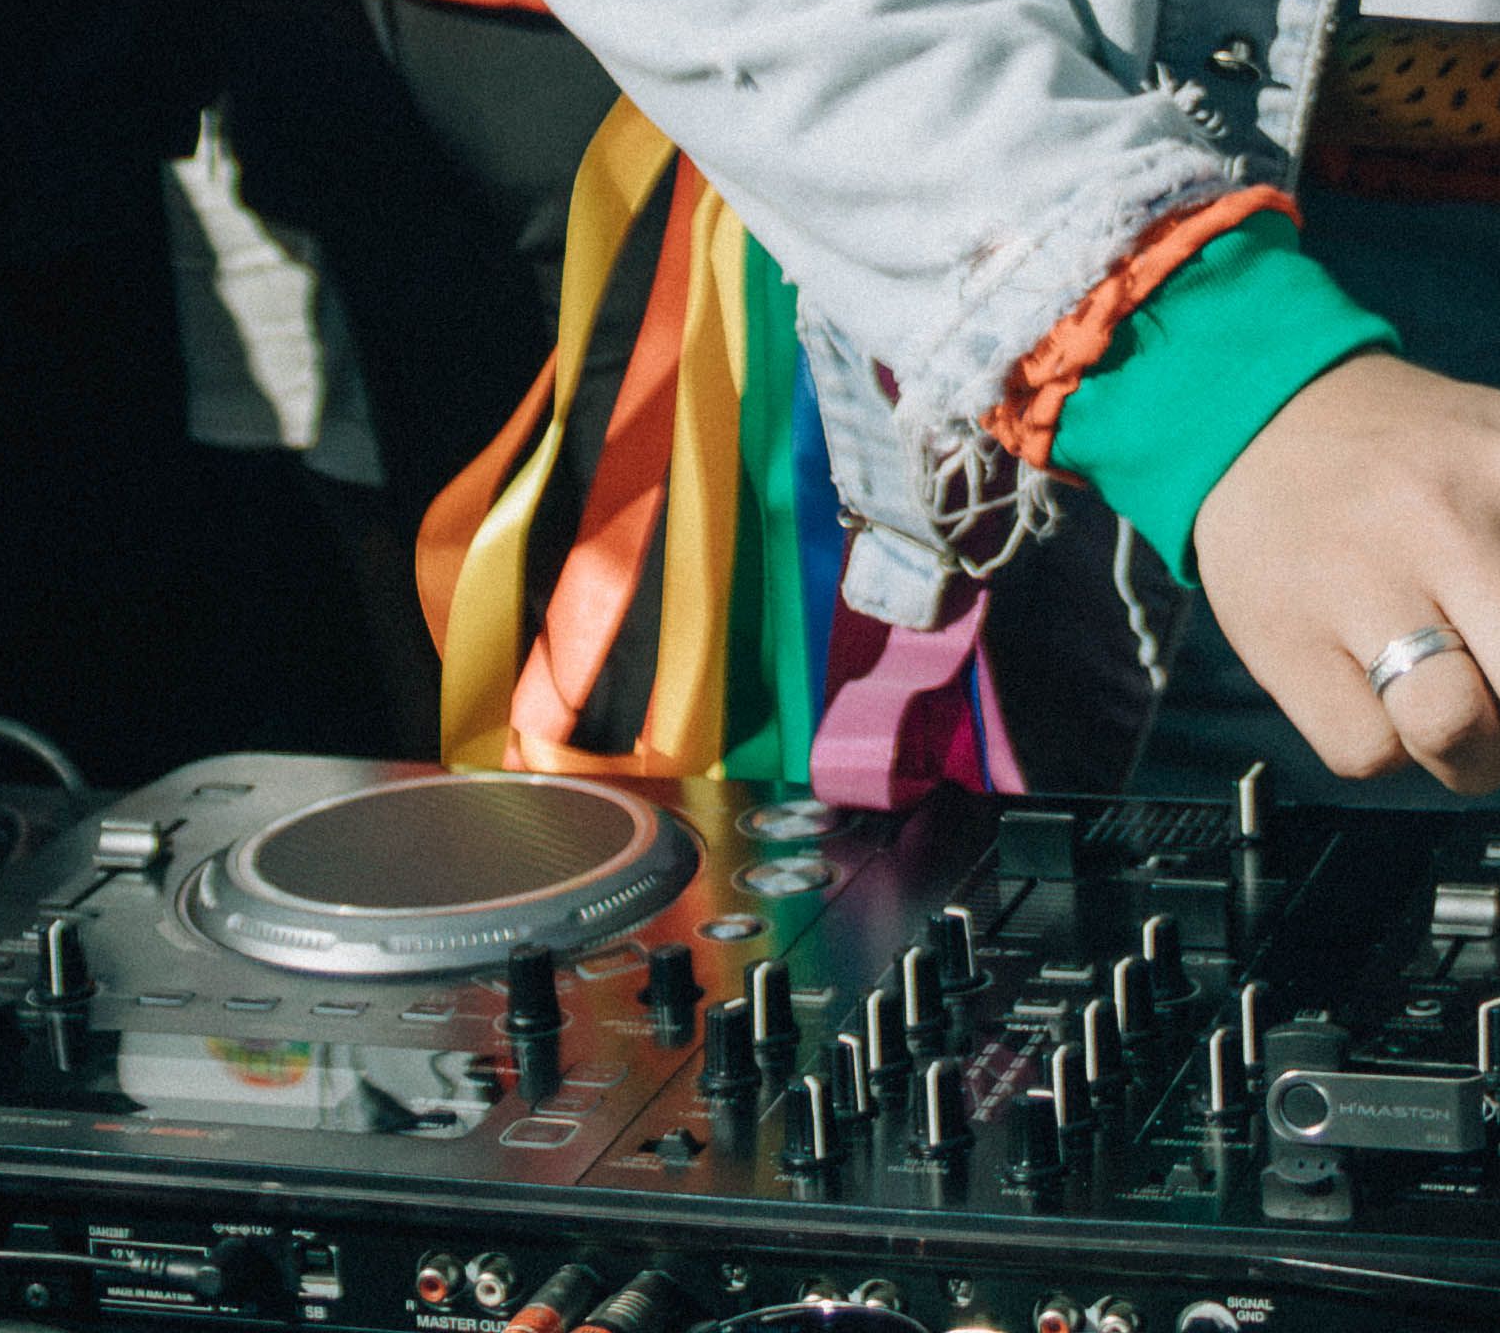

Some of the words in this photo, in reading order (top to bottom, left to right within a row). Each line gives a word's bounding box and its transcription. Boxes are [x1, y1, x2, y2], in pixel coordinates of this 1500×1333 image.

[1226, 1296, 1274, 1310] SIGNAL
[416, 1314, 476, 1331] MASTER
[1236, 1309, 1265, 1322] GND
